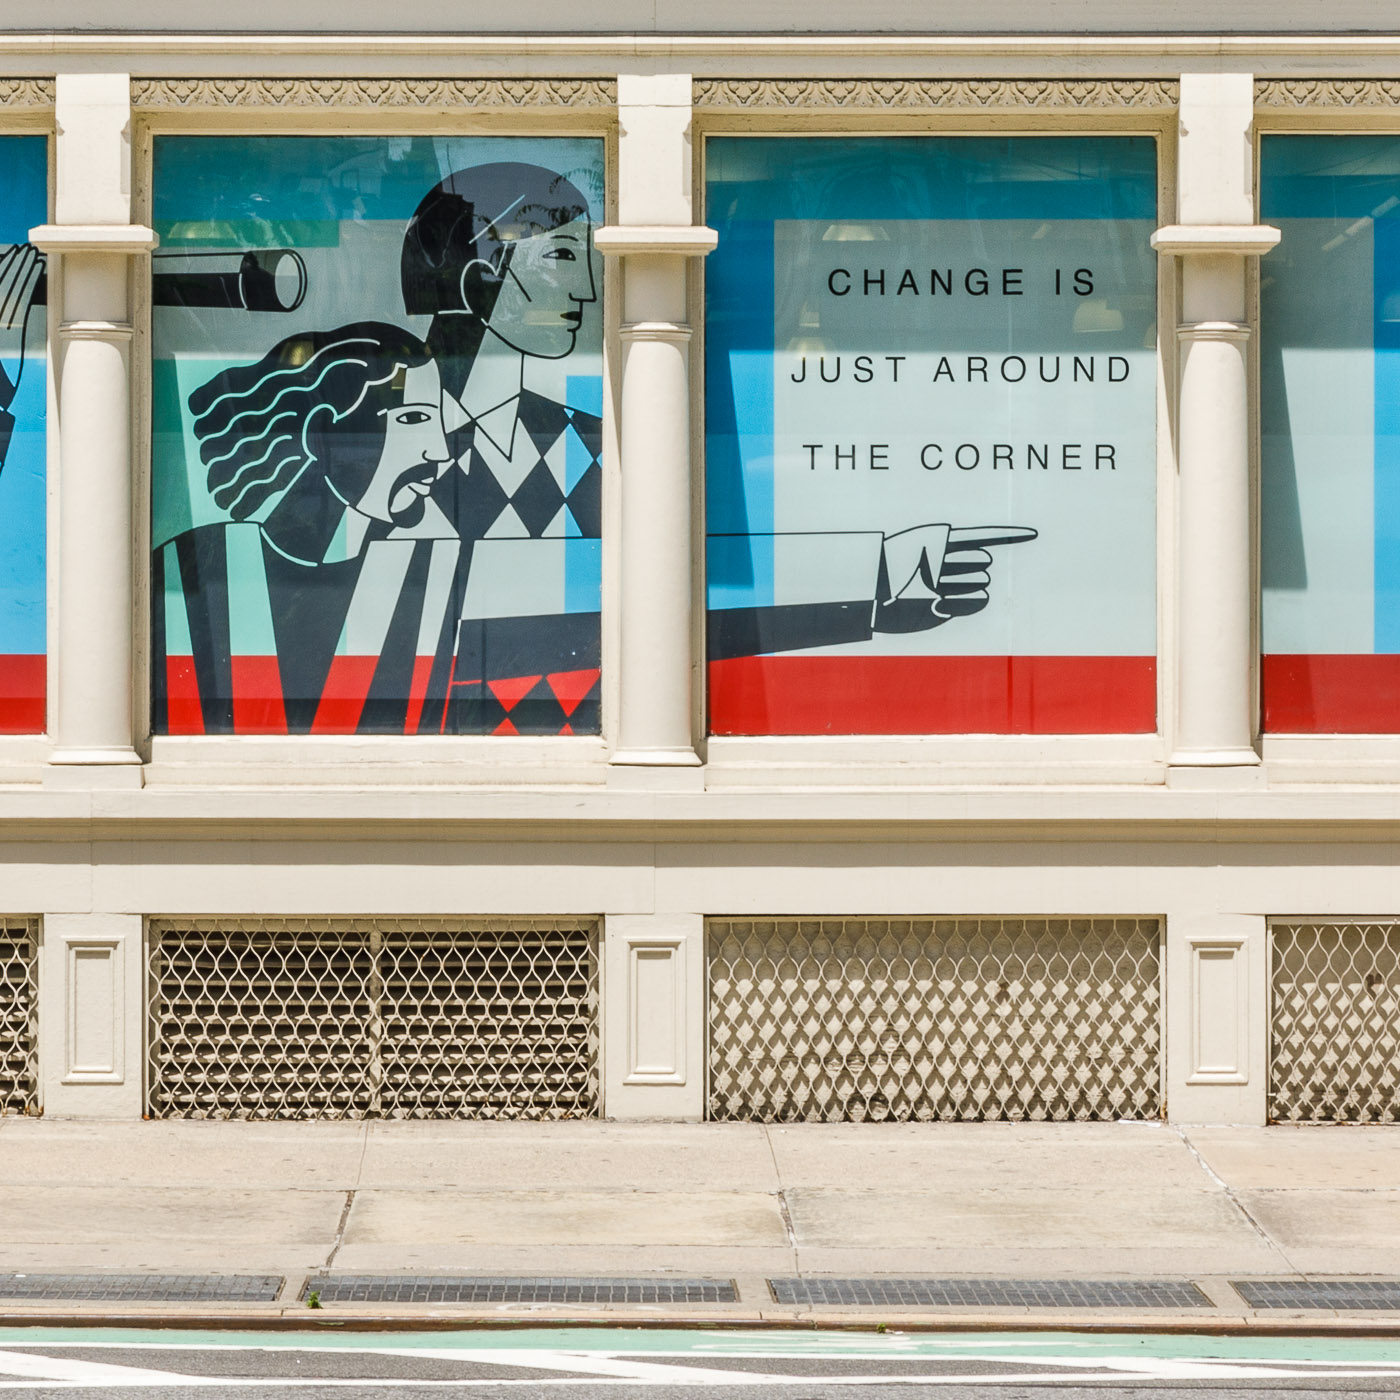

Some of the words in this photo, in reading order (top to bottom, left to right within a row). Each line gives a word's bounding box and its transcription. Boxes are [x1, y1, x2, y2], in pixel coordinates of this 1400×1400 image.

[827, 268, 1024, 297] CHANGE
[1054, 268, 1095, 297] IS
[791, 356, 906, 383] JUST
[933, 356, 1131, 383] AROUND
[802, 444, 890, 470] THE
[920, 443, 1117, 471] CORNER
